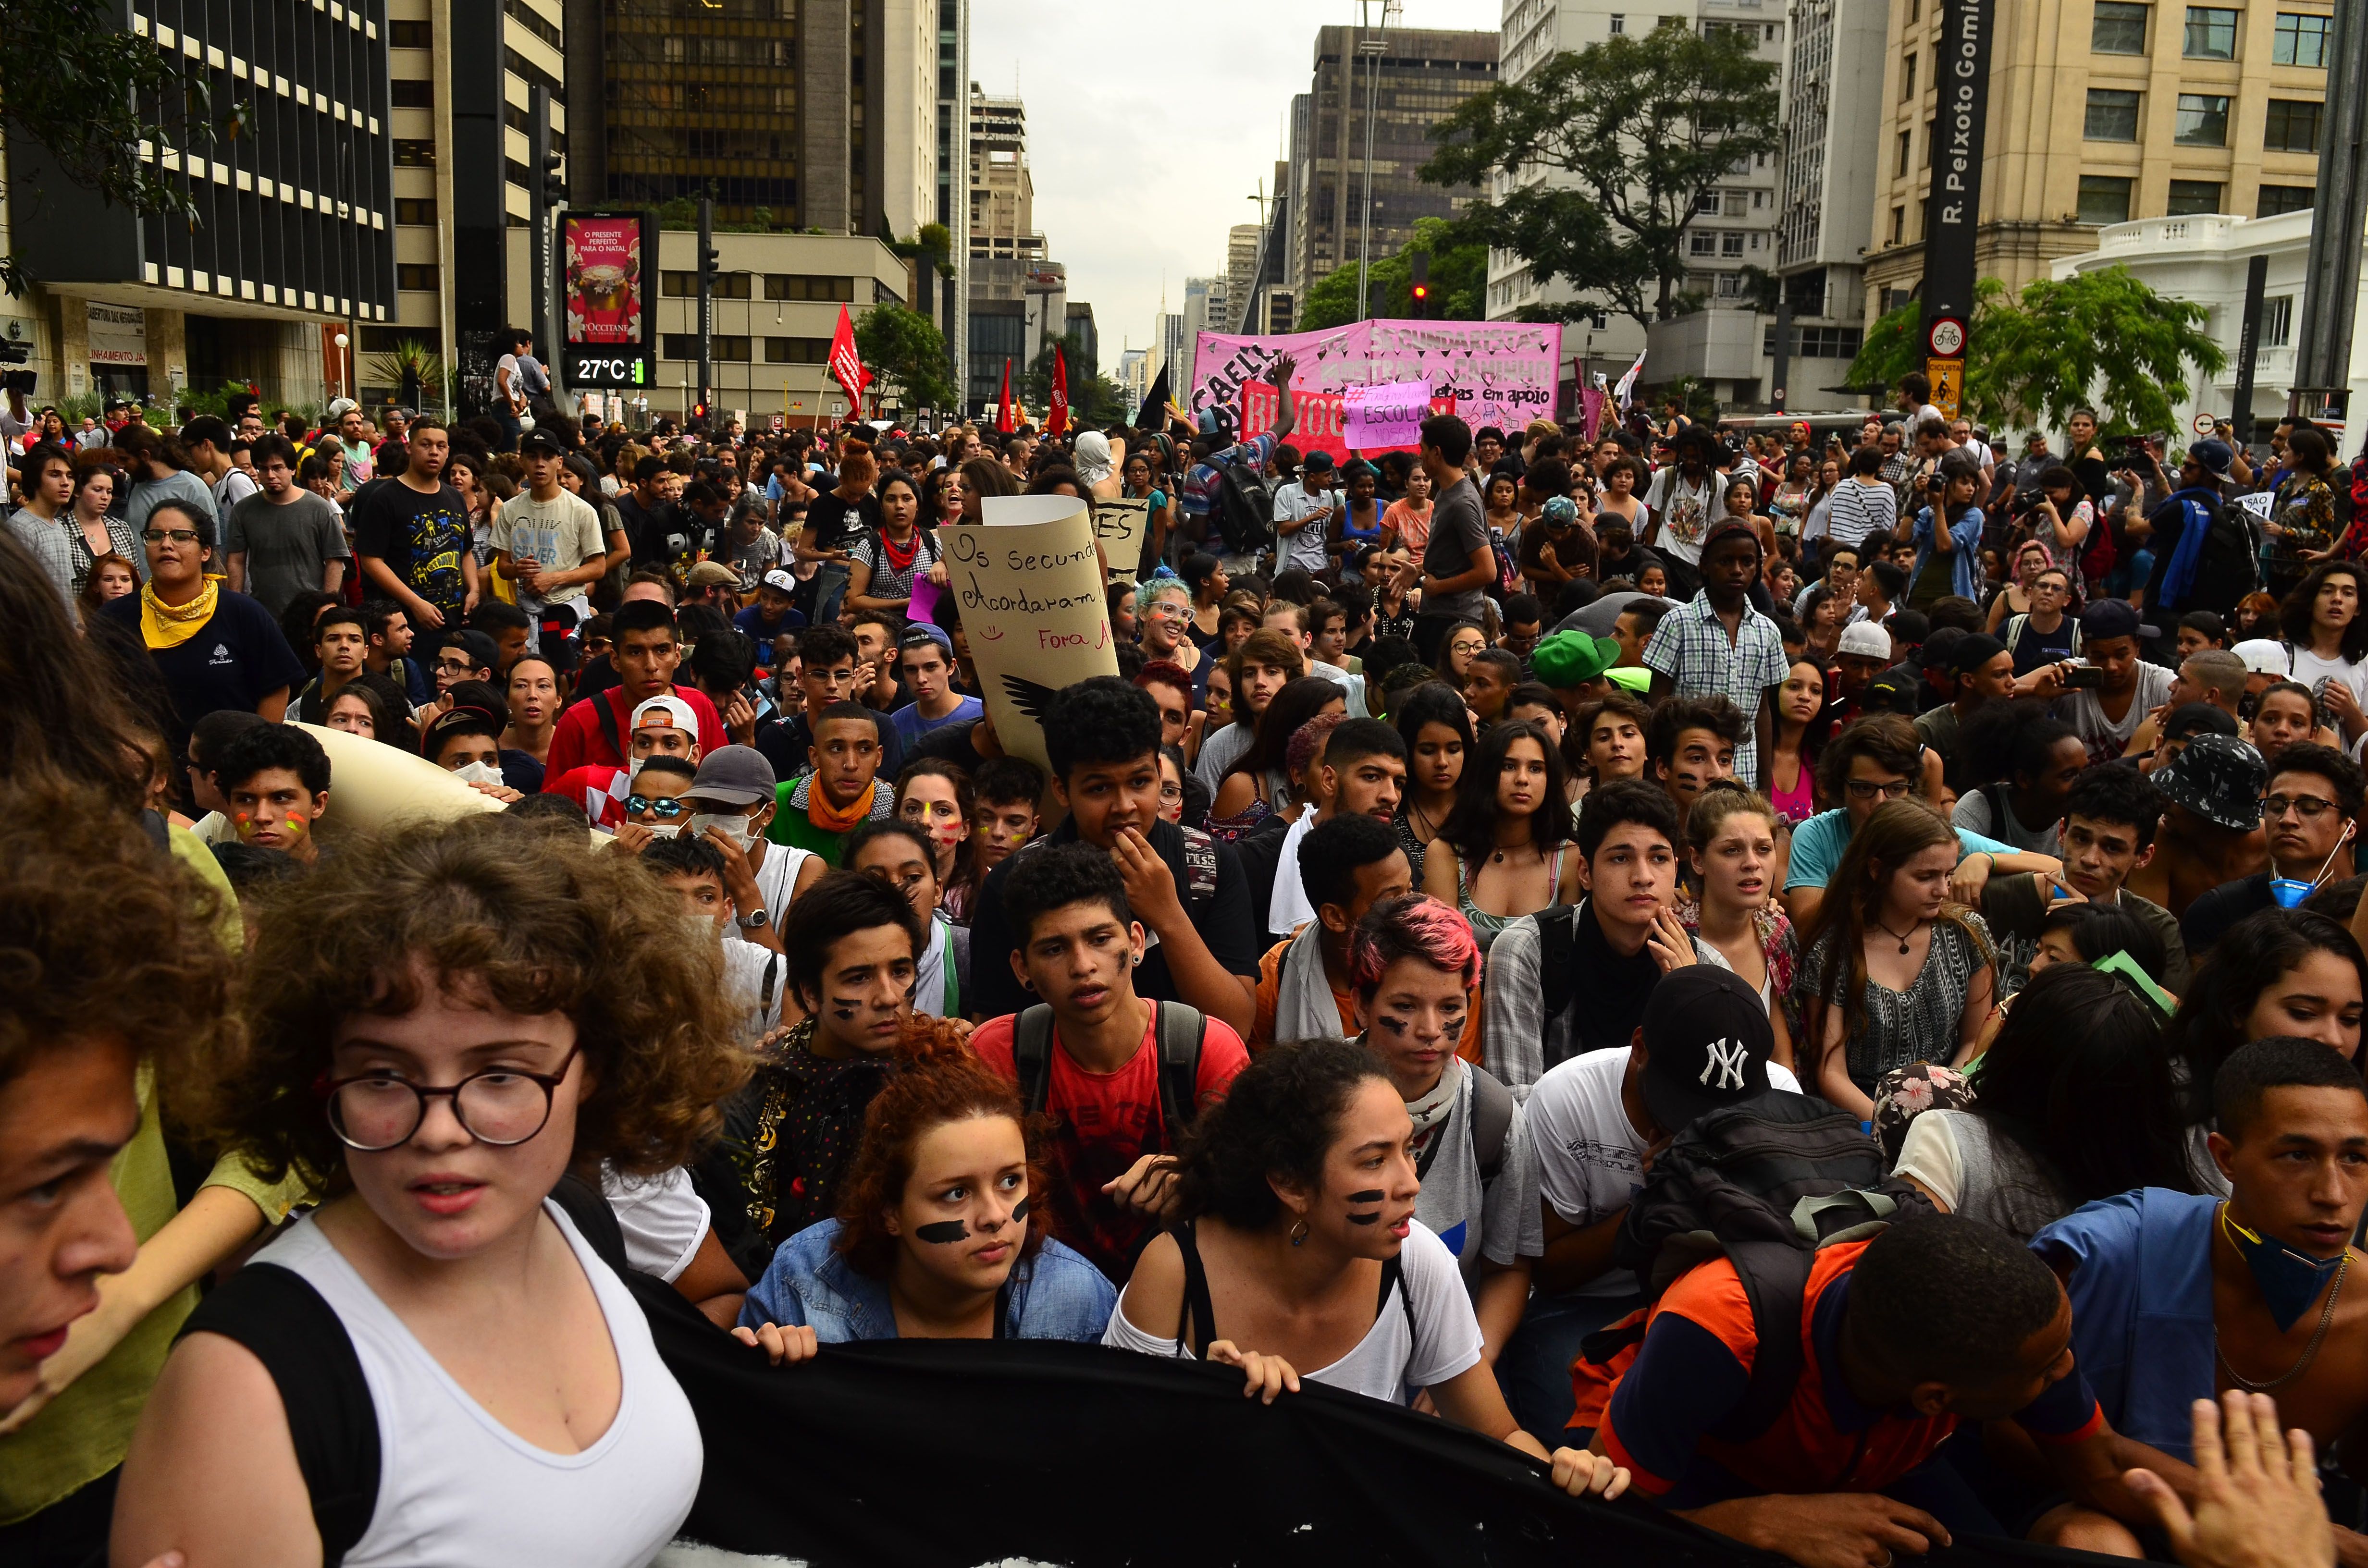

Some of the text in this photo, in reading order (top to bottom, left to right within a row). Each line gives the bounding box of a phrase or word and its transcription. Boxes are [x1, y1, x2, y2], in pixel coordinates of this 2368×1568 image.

[1942, 0, 1980, 223] R. Peixoto Gomi
[2239, 322, 2249, 371] Paulista
[1454, 358, 1551, 387] CAMINHO
[1483, 389, 1504, 402] em
[1507, 387, 1550, 408] apoio
[1364, 404, 1429, 425] ESCOLA
[1375, 426, 1417, 445] NOSSA!
[1095, 513, 1132, 539] ES
[949, 533, 990, 568] Os
[1038, 629, 1089, 650] Fora
[1698, 1037, 1749, 1091] NY
